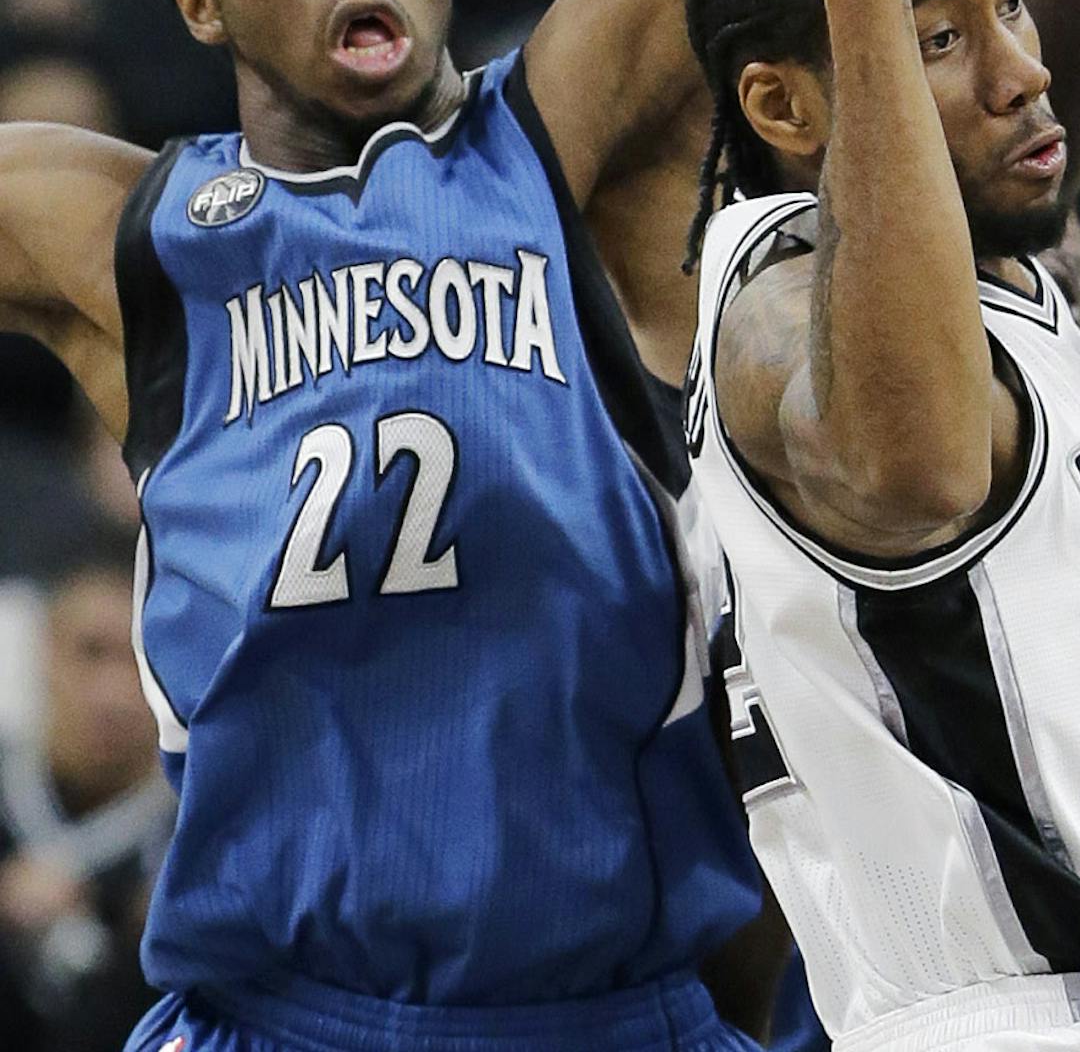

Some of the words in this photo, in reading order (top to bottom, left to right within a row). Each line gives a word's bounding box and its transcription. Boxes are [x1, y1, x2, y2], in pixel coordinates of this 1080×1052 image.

[192, 181, 257, 214] FLIP
[224, 249, 568, 428] MINNESOTA
[267, 410, 460, 612] 22
